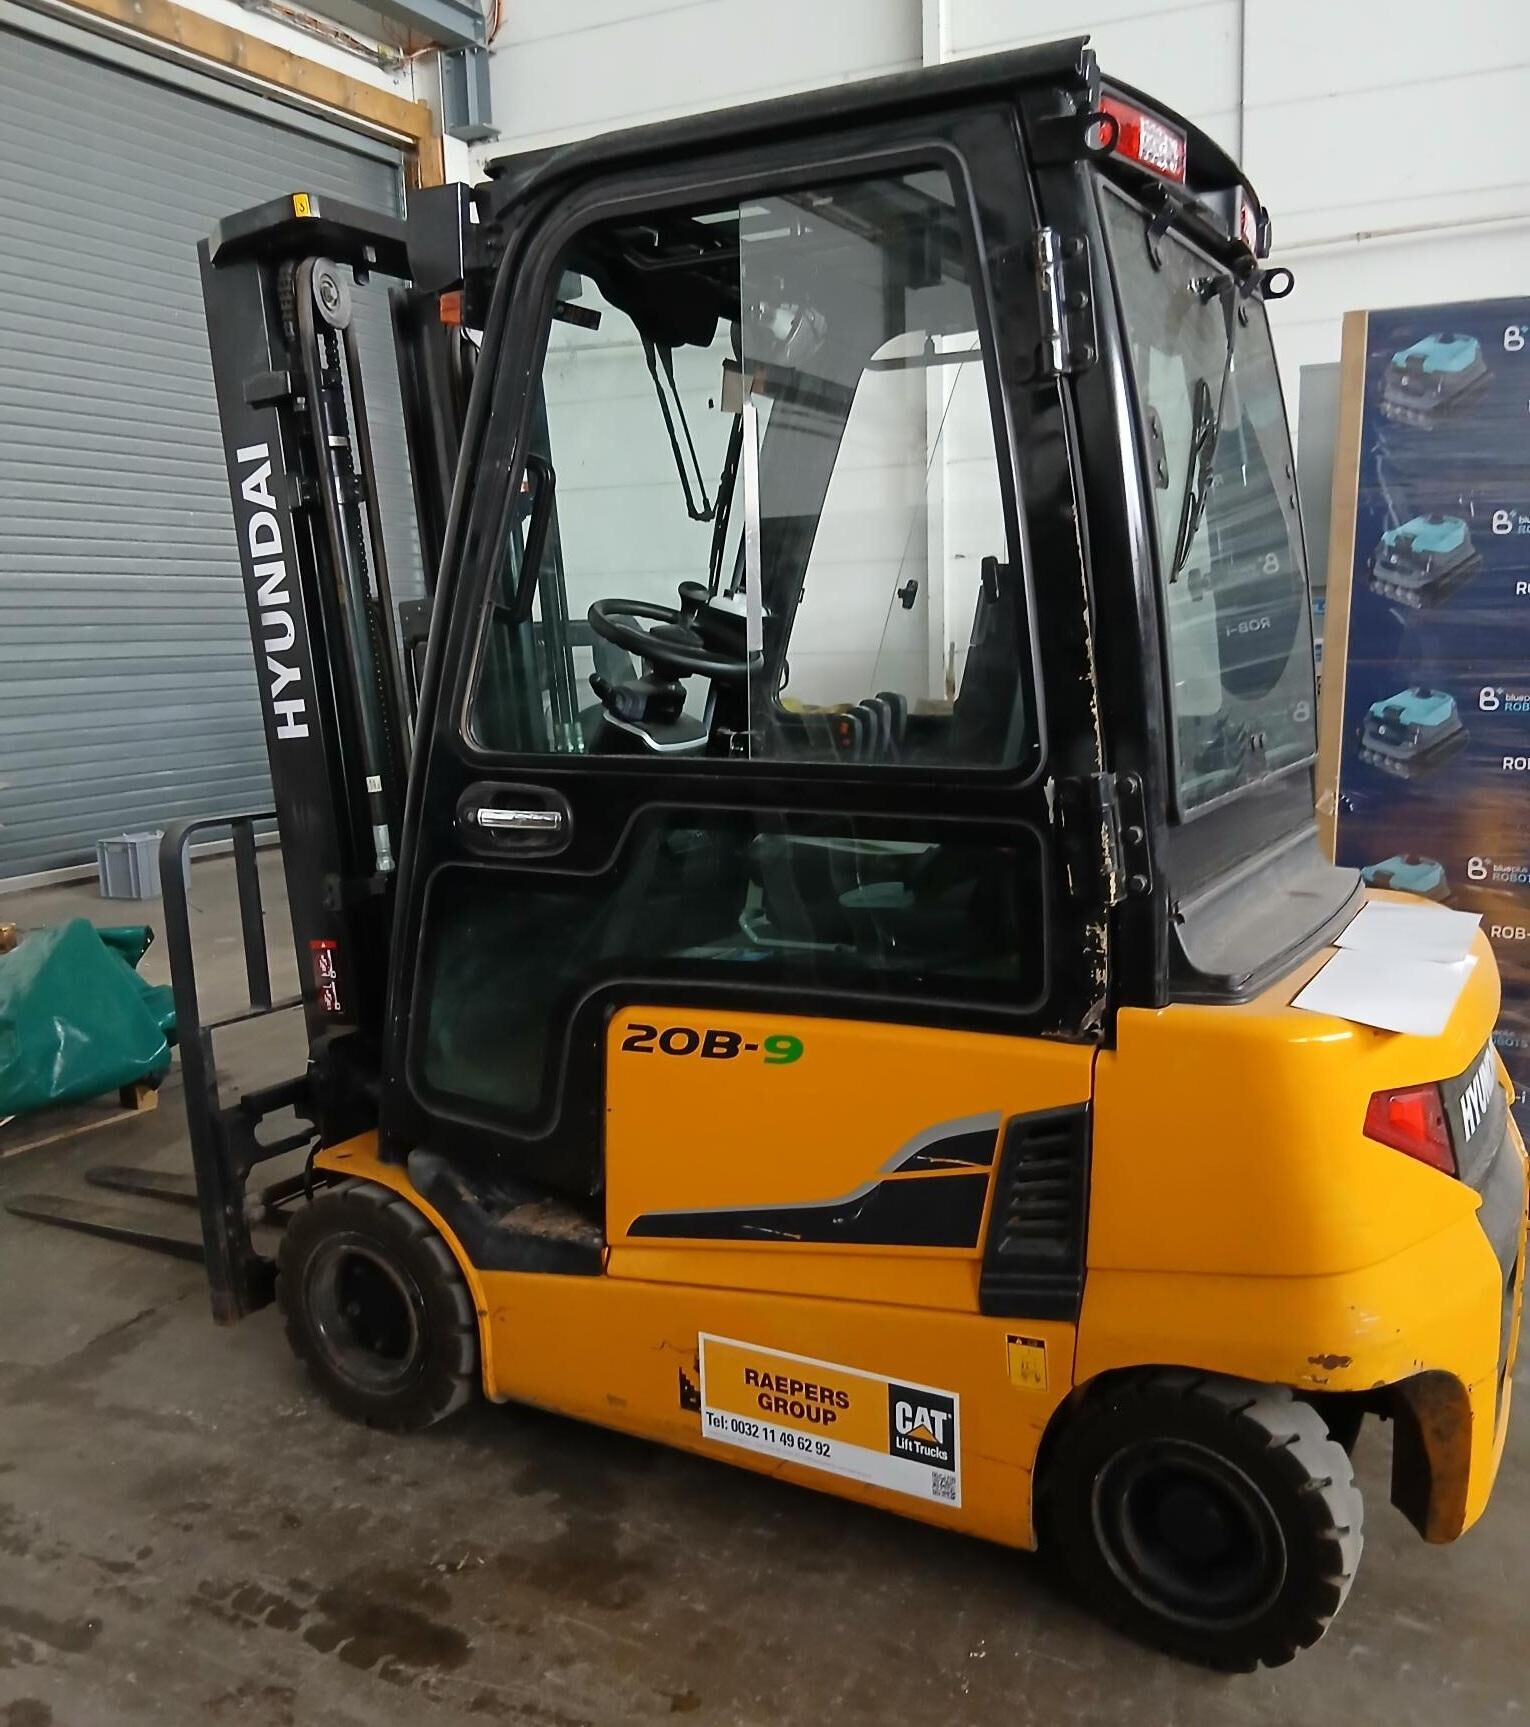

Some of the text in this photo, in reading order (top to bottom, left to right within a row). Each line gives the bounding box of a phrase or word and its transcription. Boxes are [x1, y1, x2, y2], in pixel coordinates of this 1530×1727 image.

[236, 442, 309, 739] HYUNDAI
[622, 1023, 804, 1065] 20B-9
[745, 1367, 850, 1409] RAEPERS
[757, 1392, 837, 1426] GROUP
[706, 1411, 831, 1458] Tel: 0032 11 49 62 92
[896, 1401, 947, 1445] CAT
[896, 1436, 948, 1461] Lift Trucks
